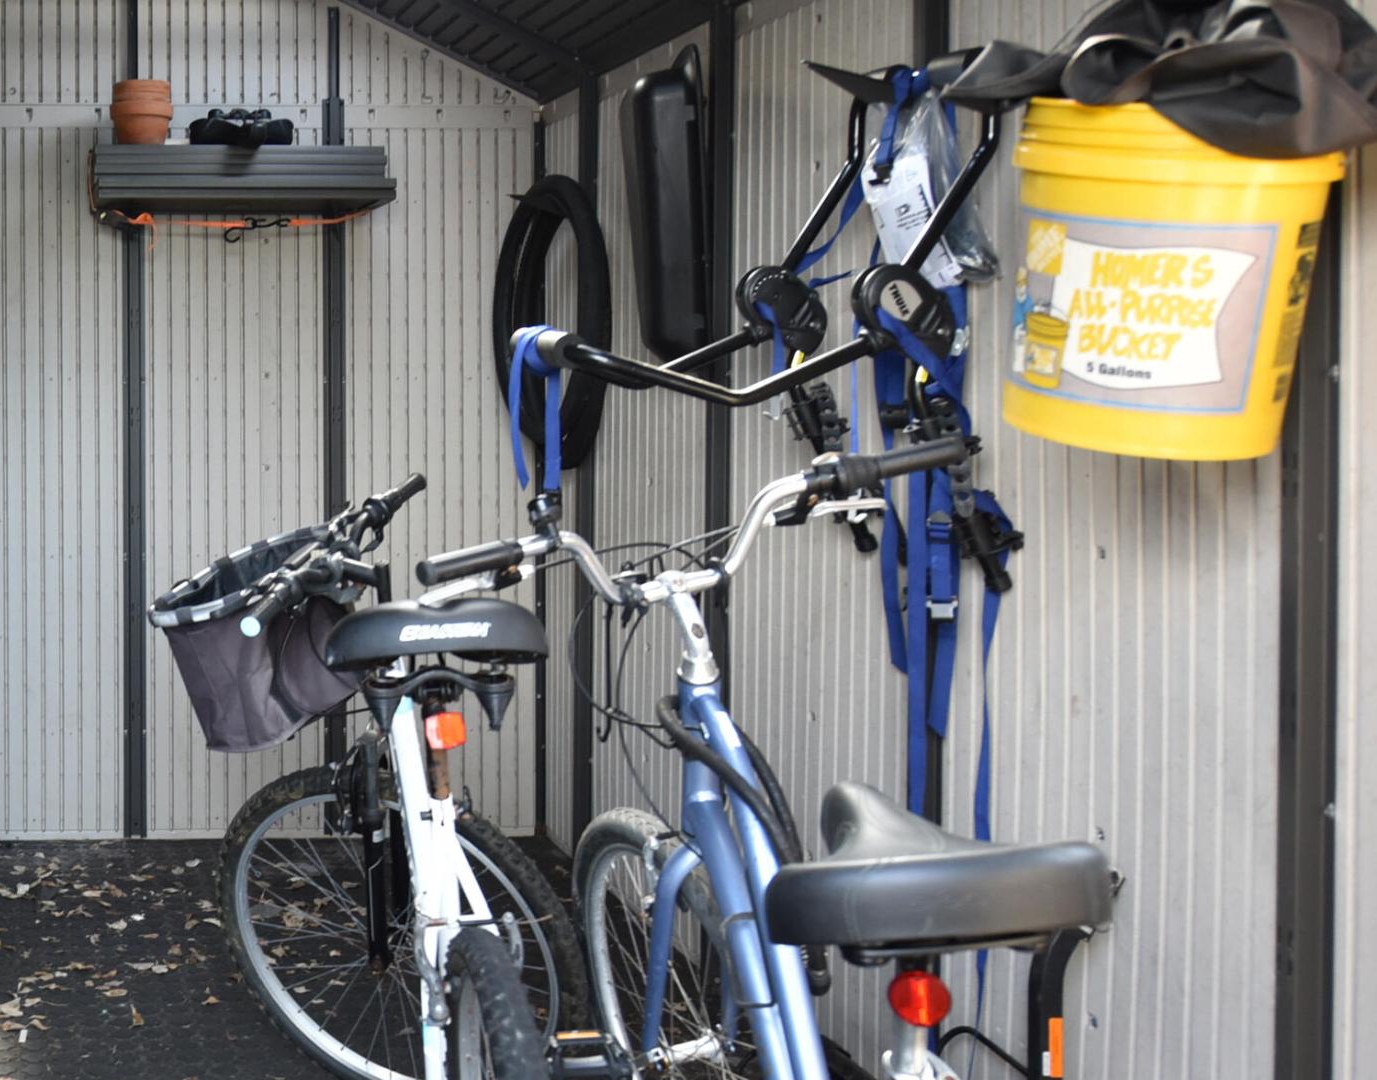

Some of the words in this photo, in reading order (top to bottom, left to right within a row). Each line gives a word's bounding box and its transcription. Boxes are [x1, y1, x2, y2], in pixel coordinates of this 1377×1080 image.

[889, 283, 910, 317] THULE
[1078, 324, 1182, 361] BUCKET
[1086, 362, 1095, 373] 5
[1099, 364, 1152, 379] Gallons
